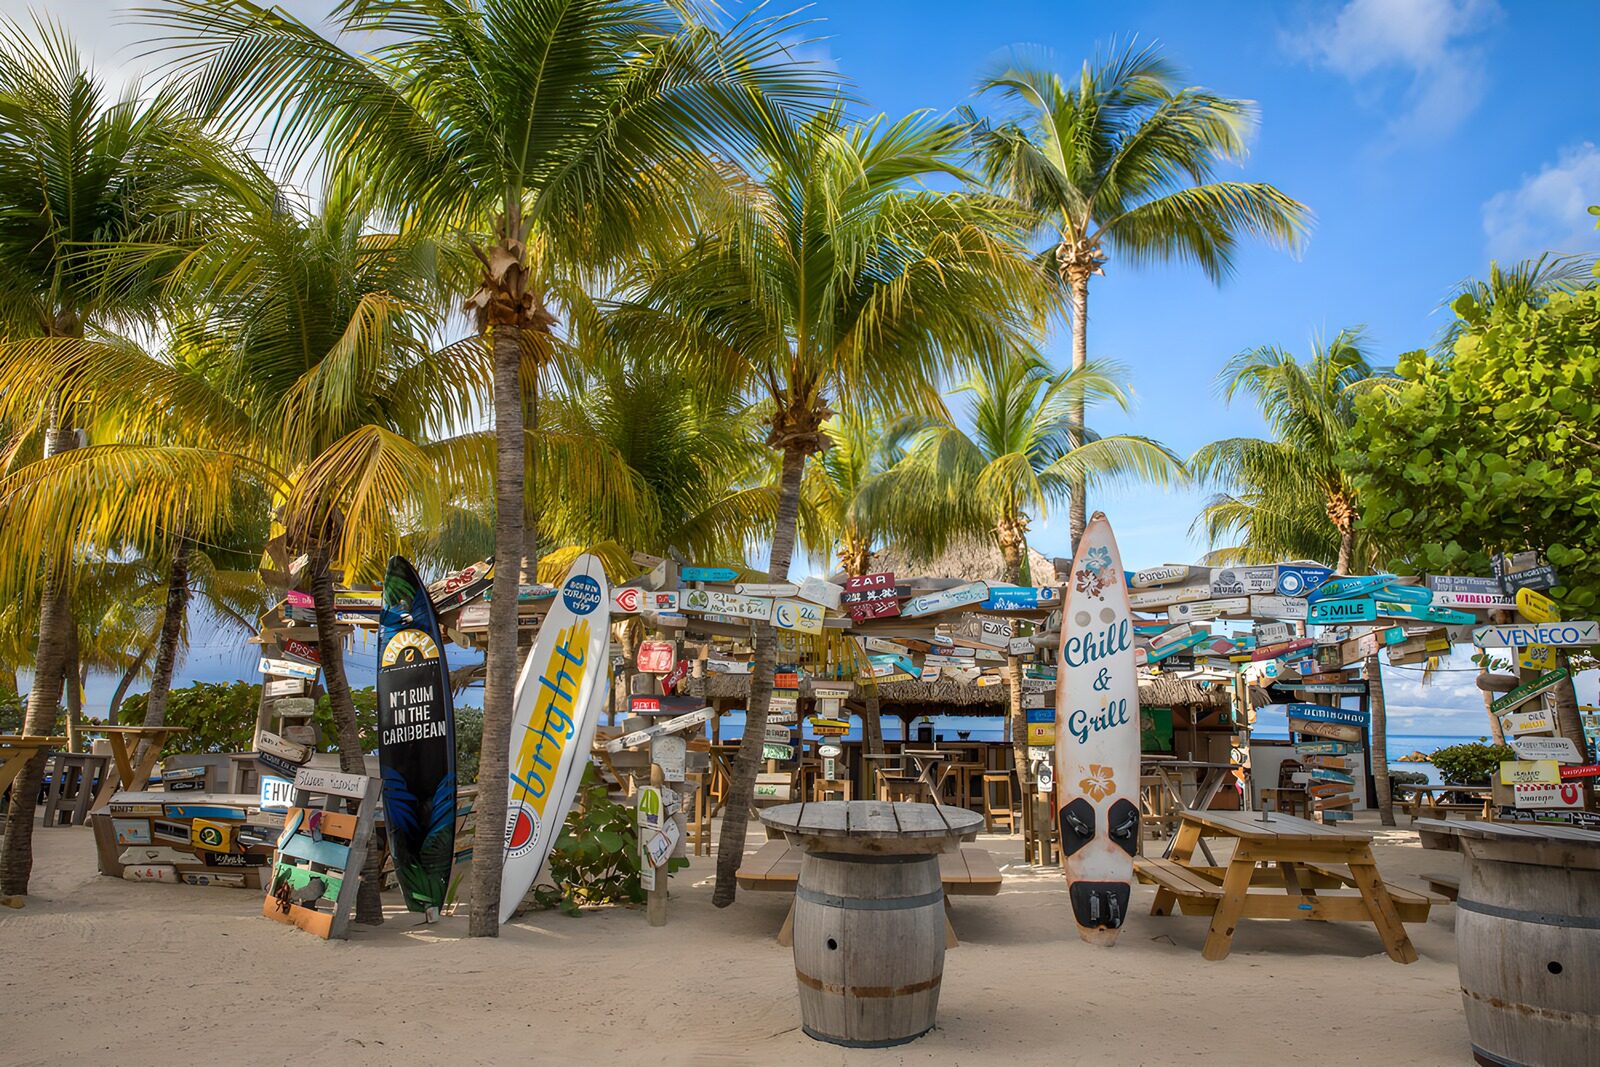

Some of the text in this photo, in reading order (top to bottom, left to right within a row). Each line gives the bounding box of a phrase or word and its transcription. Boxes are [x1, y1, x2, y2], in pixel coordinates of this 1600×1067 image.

[1320, 603, 1365, 617] SMILE
[1064, 618, 1131, 667] Chill
[1497, 627, 1580, 645] VENECO
[1092, 667, 1112, 691] &
[409, 685, 434, 704] RUM
[394, 704, 431, 726] IN THE
[510, 641, 585, 799] bright
[1068, 698, 1130, 744] Grill
[382, 720, 447, 746] CARIBBEAN
